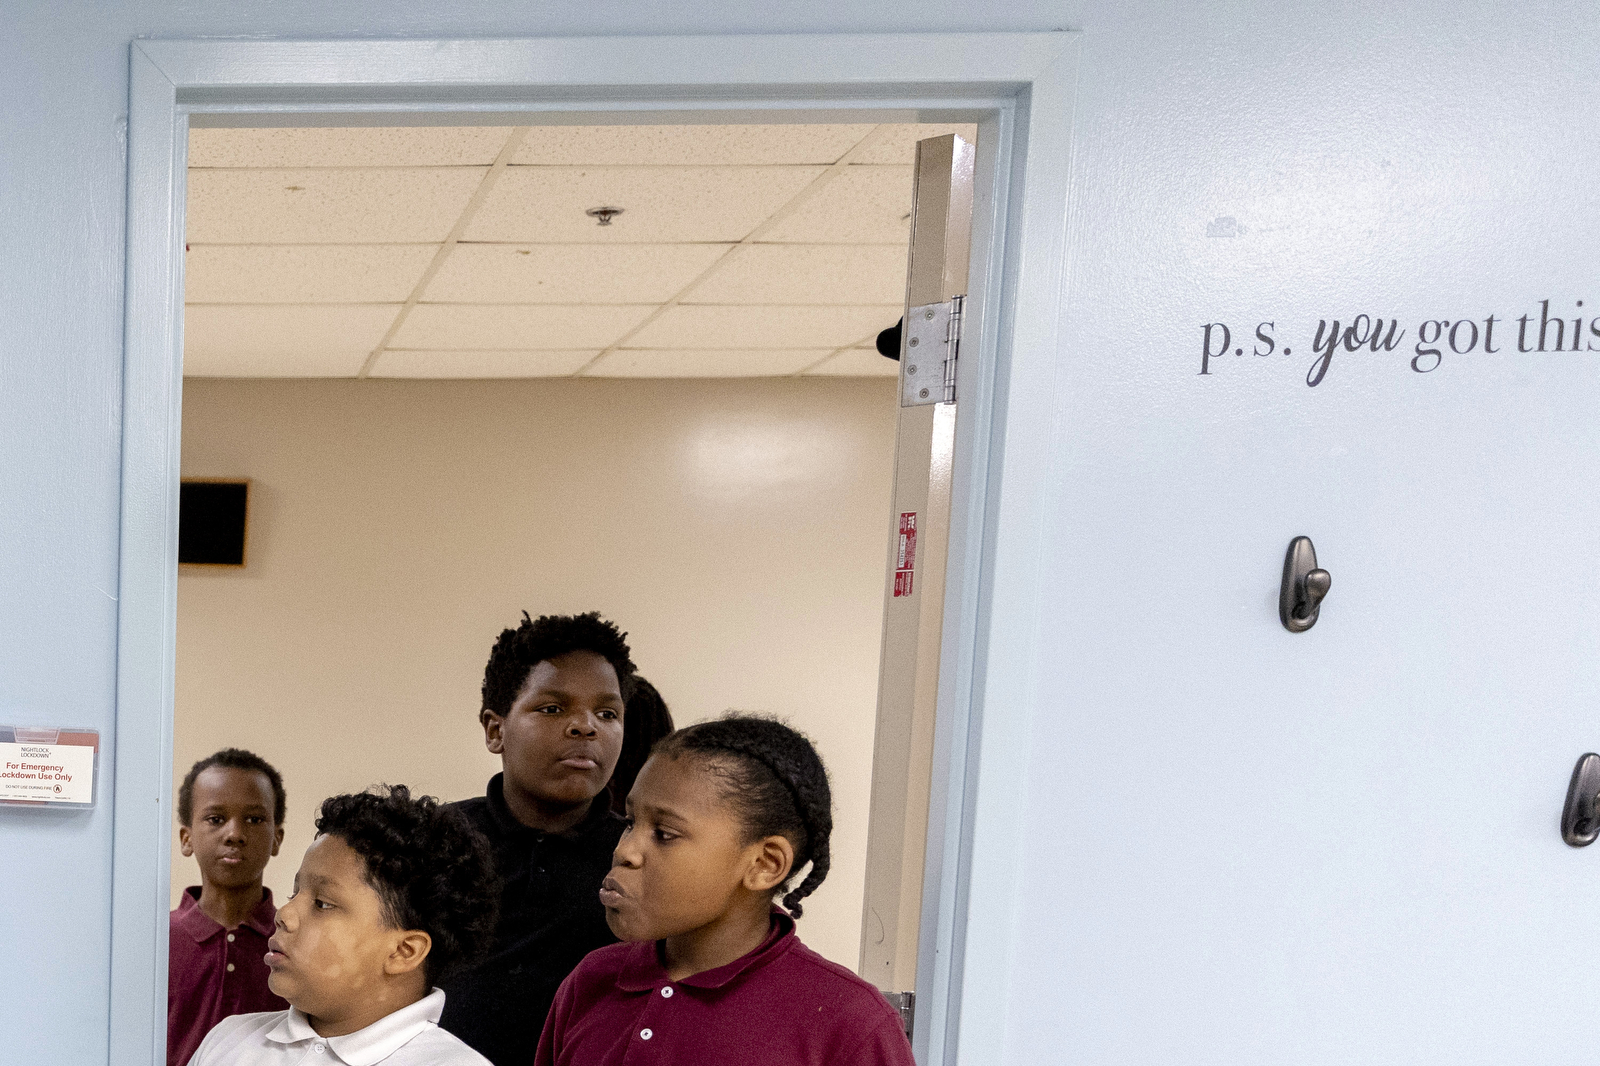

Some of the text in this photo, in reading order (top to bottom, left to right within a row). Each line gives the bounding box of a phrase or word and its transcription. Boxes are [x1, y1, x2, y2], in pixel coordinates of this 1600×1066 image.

[1197, 320, 1292, 375] p.s.
[1306, 313, 1406, 388] you
[1410, 313, 1502, 373] got
[21, 763, 64, 773] Emergency
[55, 773, 72, 782] Only
